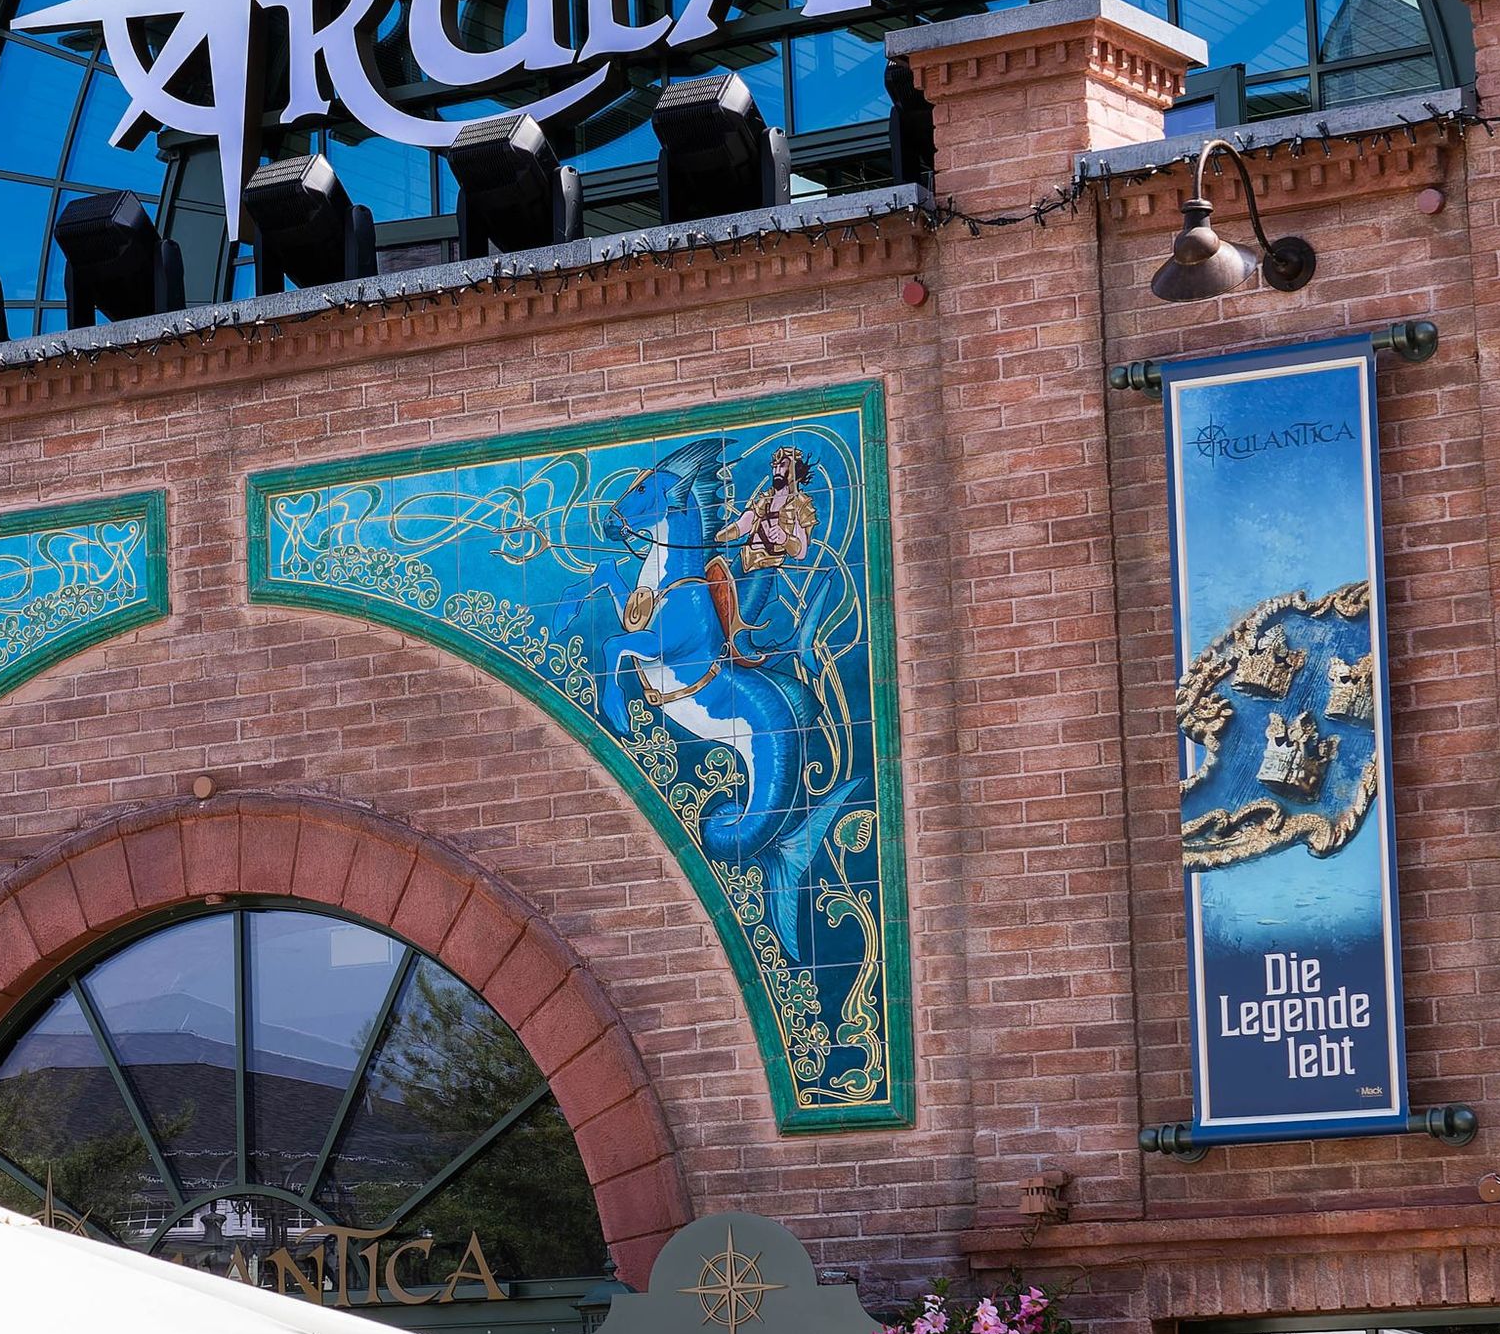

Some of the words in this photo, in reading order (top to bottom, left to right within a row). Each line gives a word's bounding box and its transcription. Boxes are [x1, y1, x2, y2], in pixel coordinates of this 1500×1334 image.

[1217, 420, 1356, 460] RULANTICA
[1263, 952, 1321, 996] Die
[1218, 986, 1371, 1043] Legende
[1286, 1034, 1356, 1079] lebt
[170, 1221, 509, 1308] ANTICA
